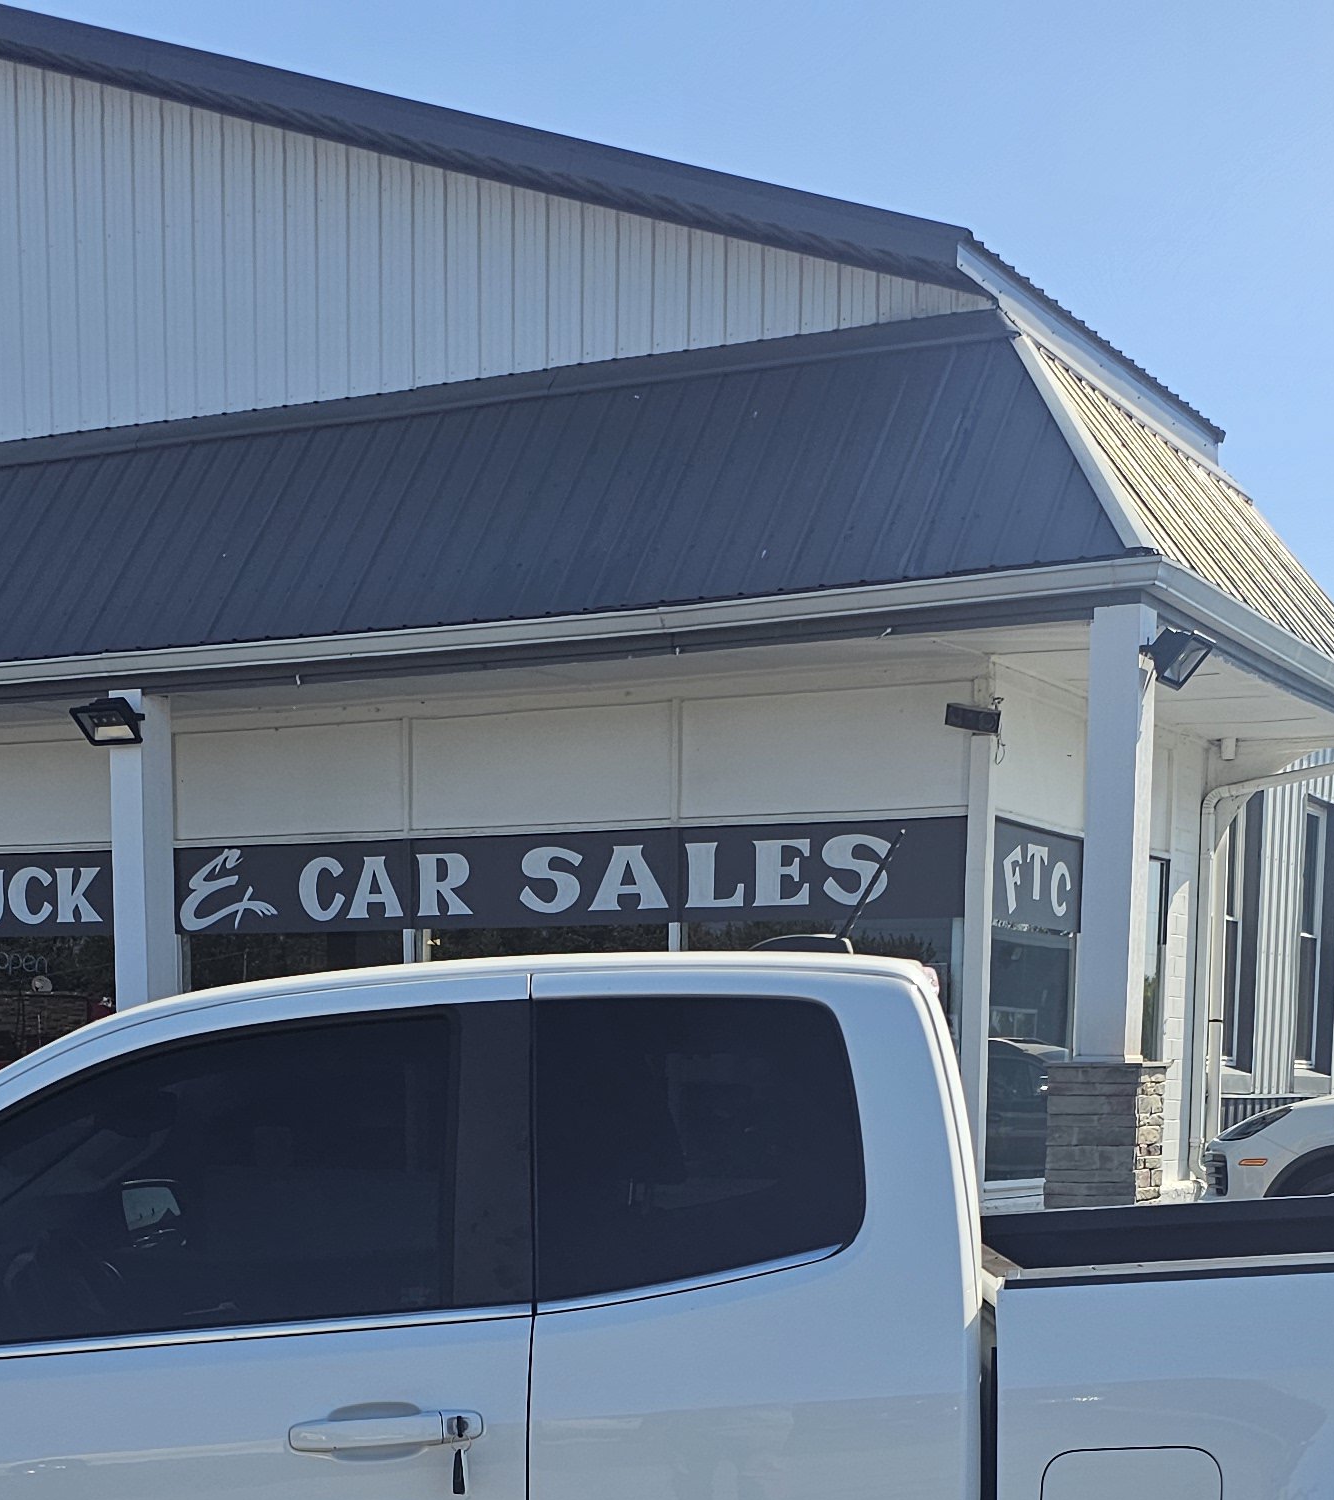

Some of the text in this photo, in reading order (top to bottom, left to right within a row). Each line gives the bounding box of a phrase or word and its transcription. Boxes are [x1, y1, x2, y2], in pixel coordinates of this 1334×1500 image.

[298, 852, 474, 922] CAR
[519, 833, 893, 915] SALES
[1002, 843, 1072, 917] FTC
